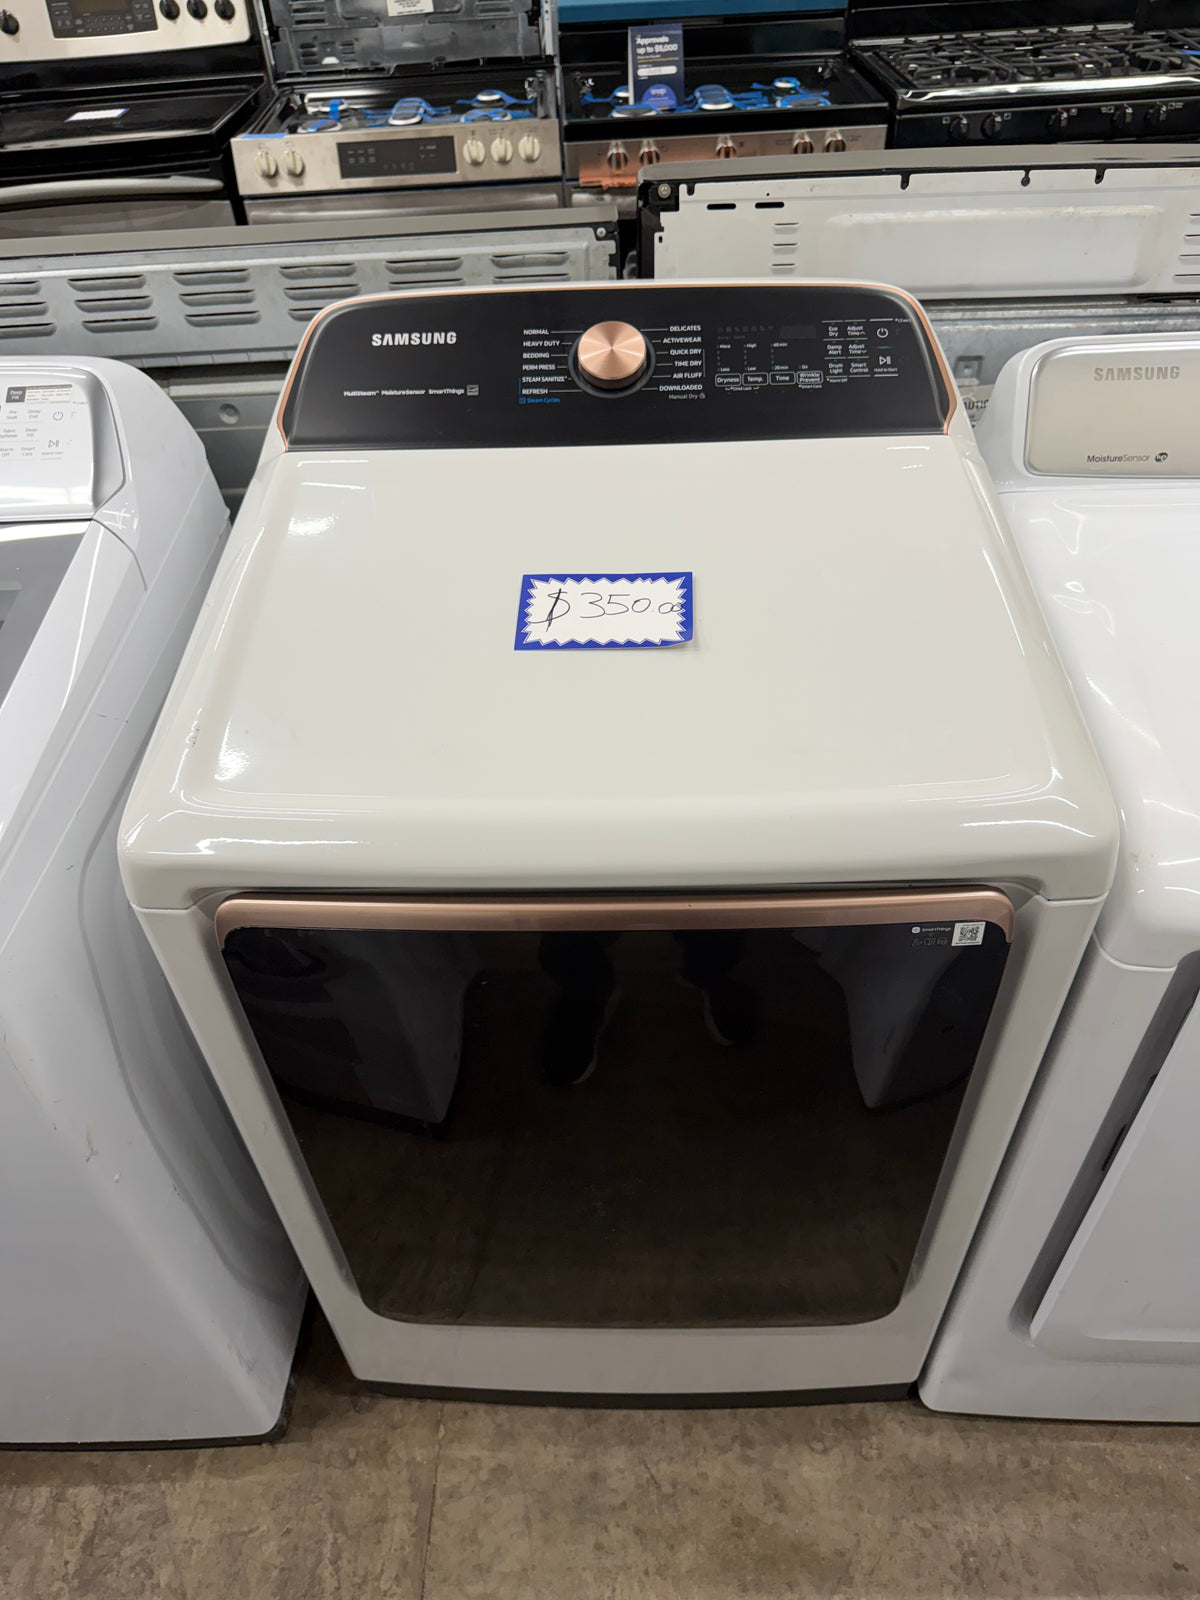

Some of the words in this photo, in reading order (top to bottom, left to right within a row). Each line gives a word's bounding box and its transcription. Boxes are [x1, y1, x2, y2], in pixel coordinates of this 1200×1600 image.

[636, 35, 669, 45] Approvals
[372, 331, 457, 346] SAMSUNG
[1093, 366, 1181, 381] SAMSUNG
[1086, 455, 1150, 463] MoistureSensor
[529, 588, 571, 632] $
